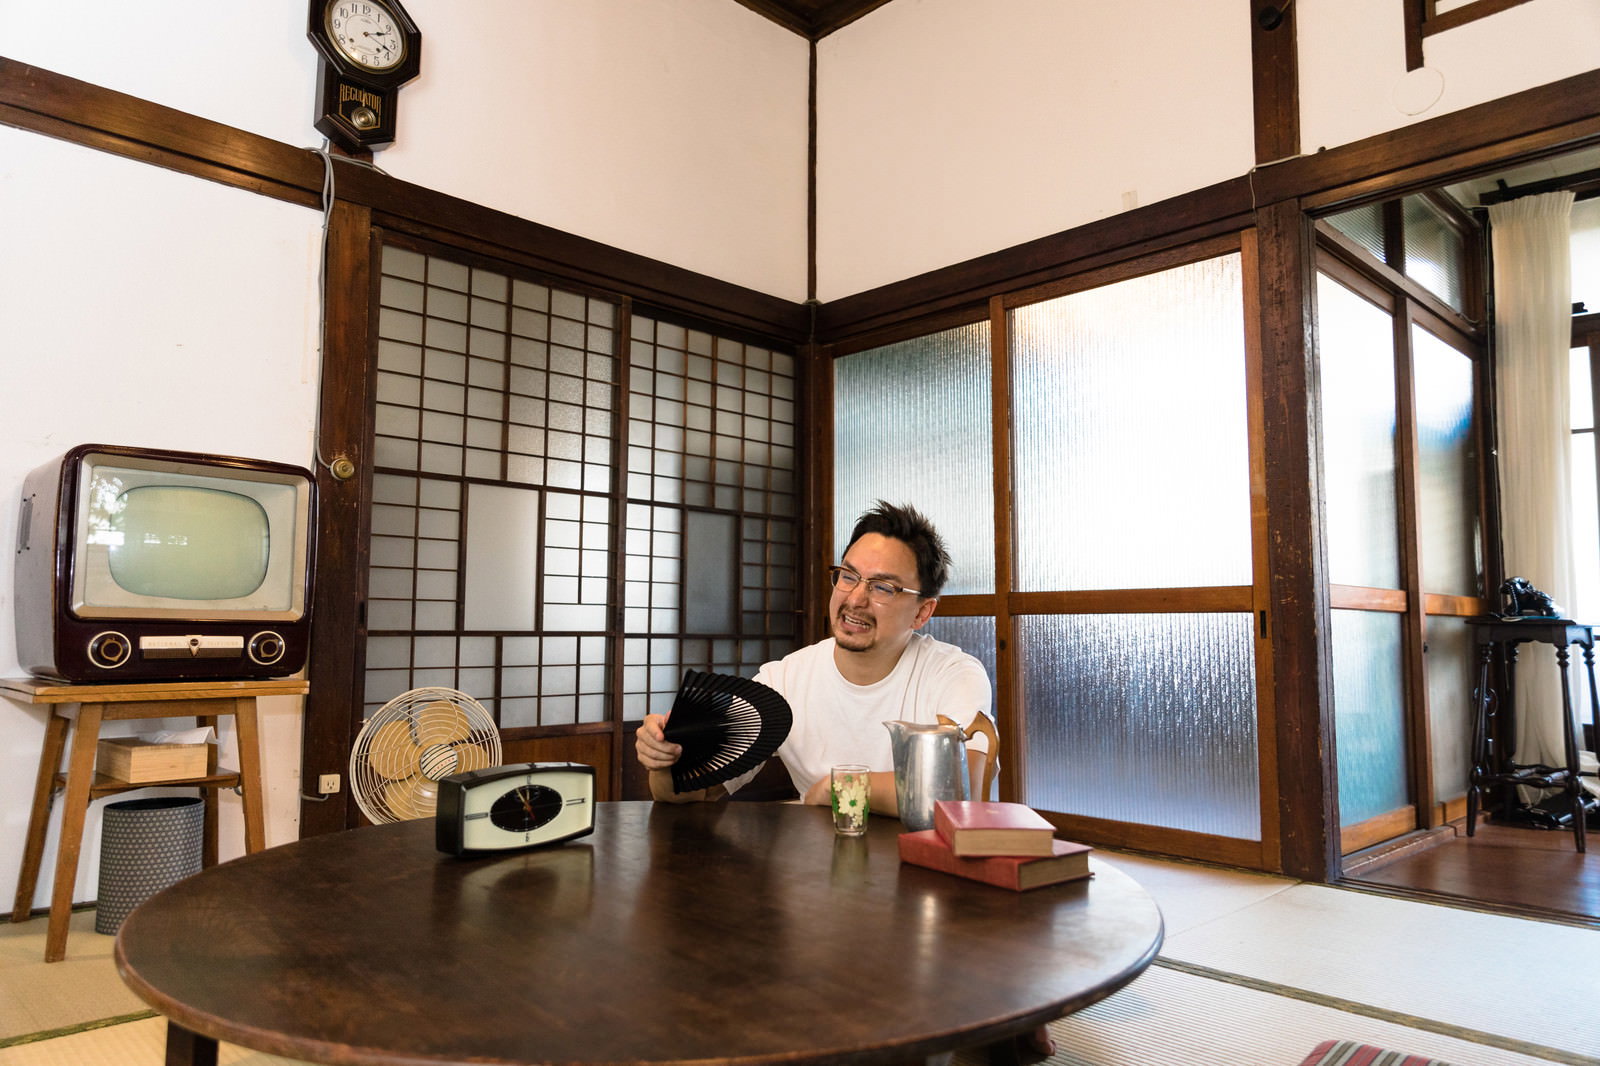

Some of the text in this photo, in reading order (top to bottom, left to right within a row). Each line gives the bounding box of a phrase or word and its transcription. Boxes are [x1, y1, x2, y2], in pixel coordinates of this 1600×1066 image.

[340, 7, 348, 19] 10
[352, 3, 357, 14] 11
[363, 5, 371, 17] 12
[334, 19, 340, 29] 9
[340, 83, 381, 112] REGULATOR
